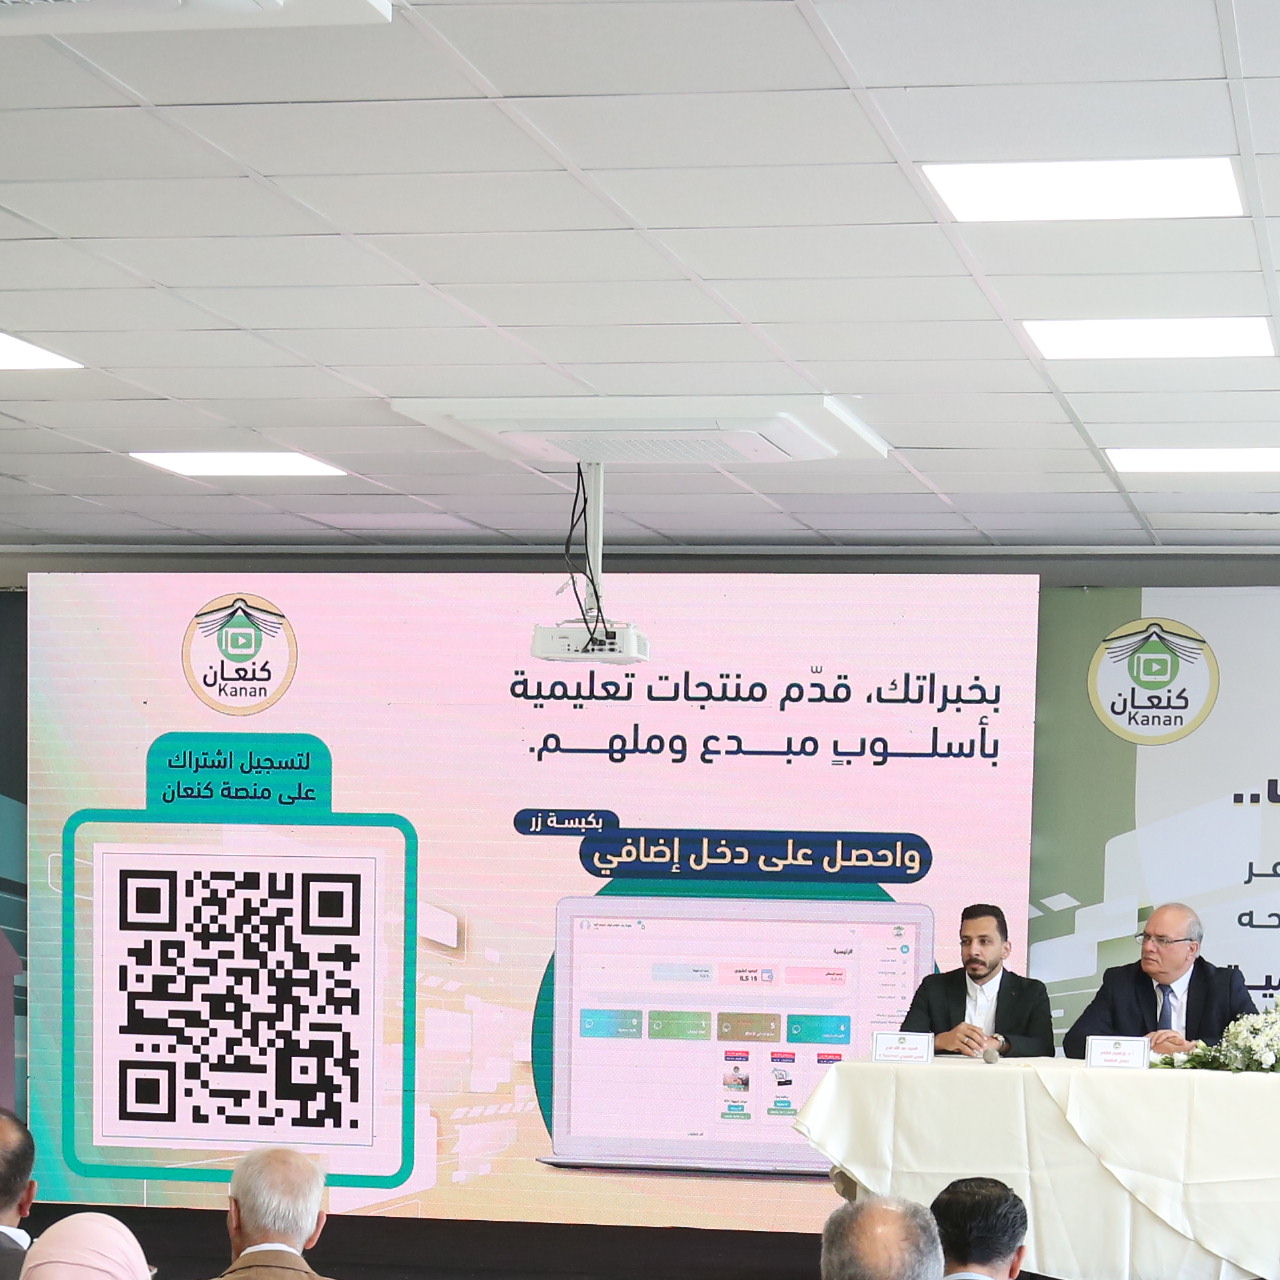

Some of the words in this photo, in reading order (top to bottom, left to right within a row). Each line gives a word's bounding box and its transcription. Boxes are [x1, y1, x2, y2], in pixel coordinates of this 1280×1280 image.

[202, 660, 272, 688] كنعان
[778, 665, 852, 711] قدّم
[218, 683, 268, 698] Kanan
[509, 669, 634, 710] تعليمية
[646, 671, 769, 710] منتجات
[865, 672, 1002, 714] بخبراتك،
[1110, 687, 1189, 716] كنعان
[1127, 711, 1184, 726] Kanan
[528, 723, 688, 763] وملهم.
[700, 732, 820, 764] مبدع
[167, 749, 234, 771] اشتراك
[239, 750, 311, 774] لتسجيل
[161, 782, 214, 804] كنعان
[220, 781, 272, 801] منصة
[278, 782, 317, 806] على
[529, 813, 544, 833] زر
[545, 811, 604, 832] بكبسة
[592, 837, 681, 878] إضافي
[689, 838, 751, 868] دخل
[757, 839, 813, 872] على
[822, 840, 921, 873] واحصل
